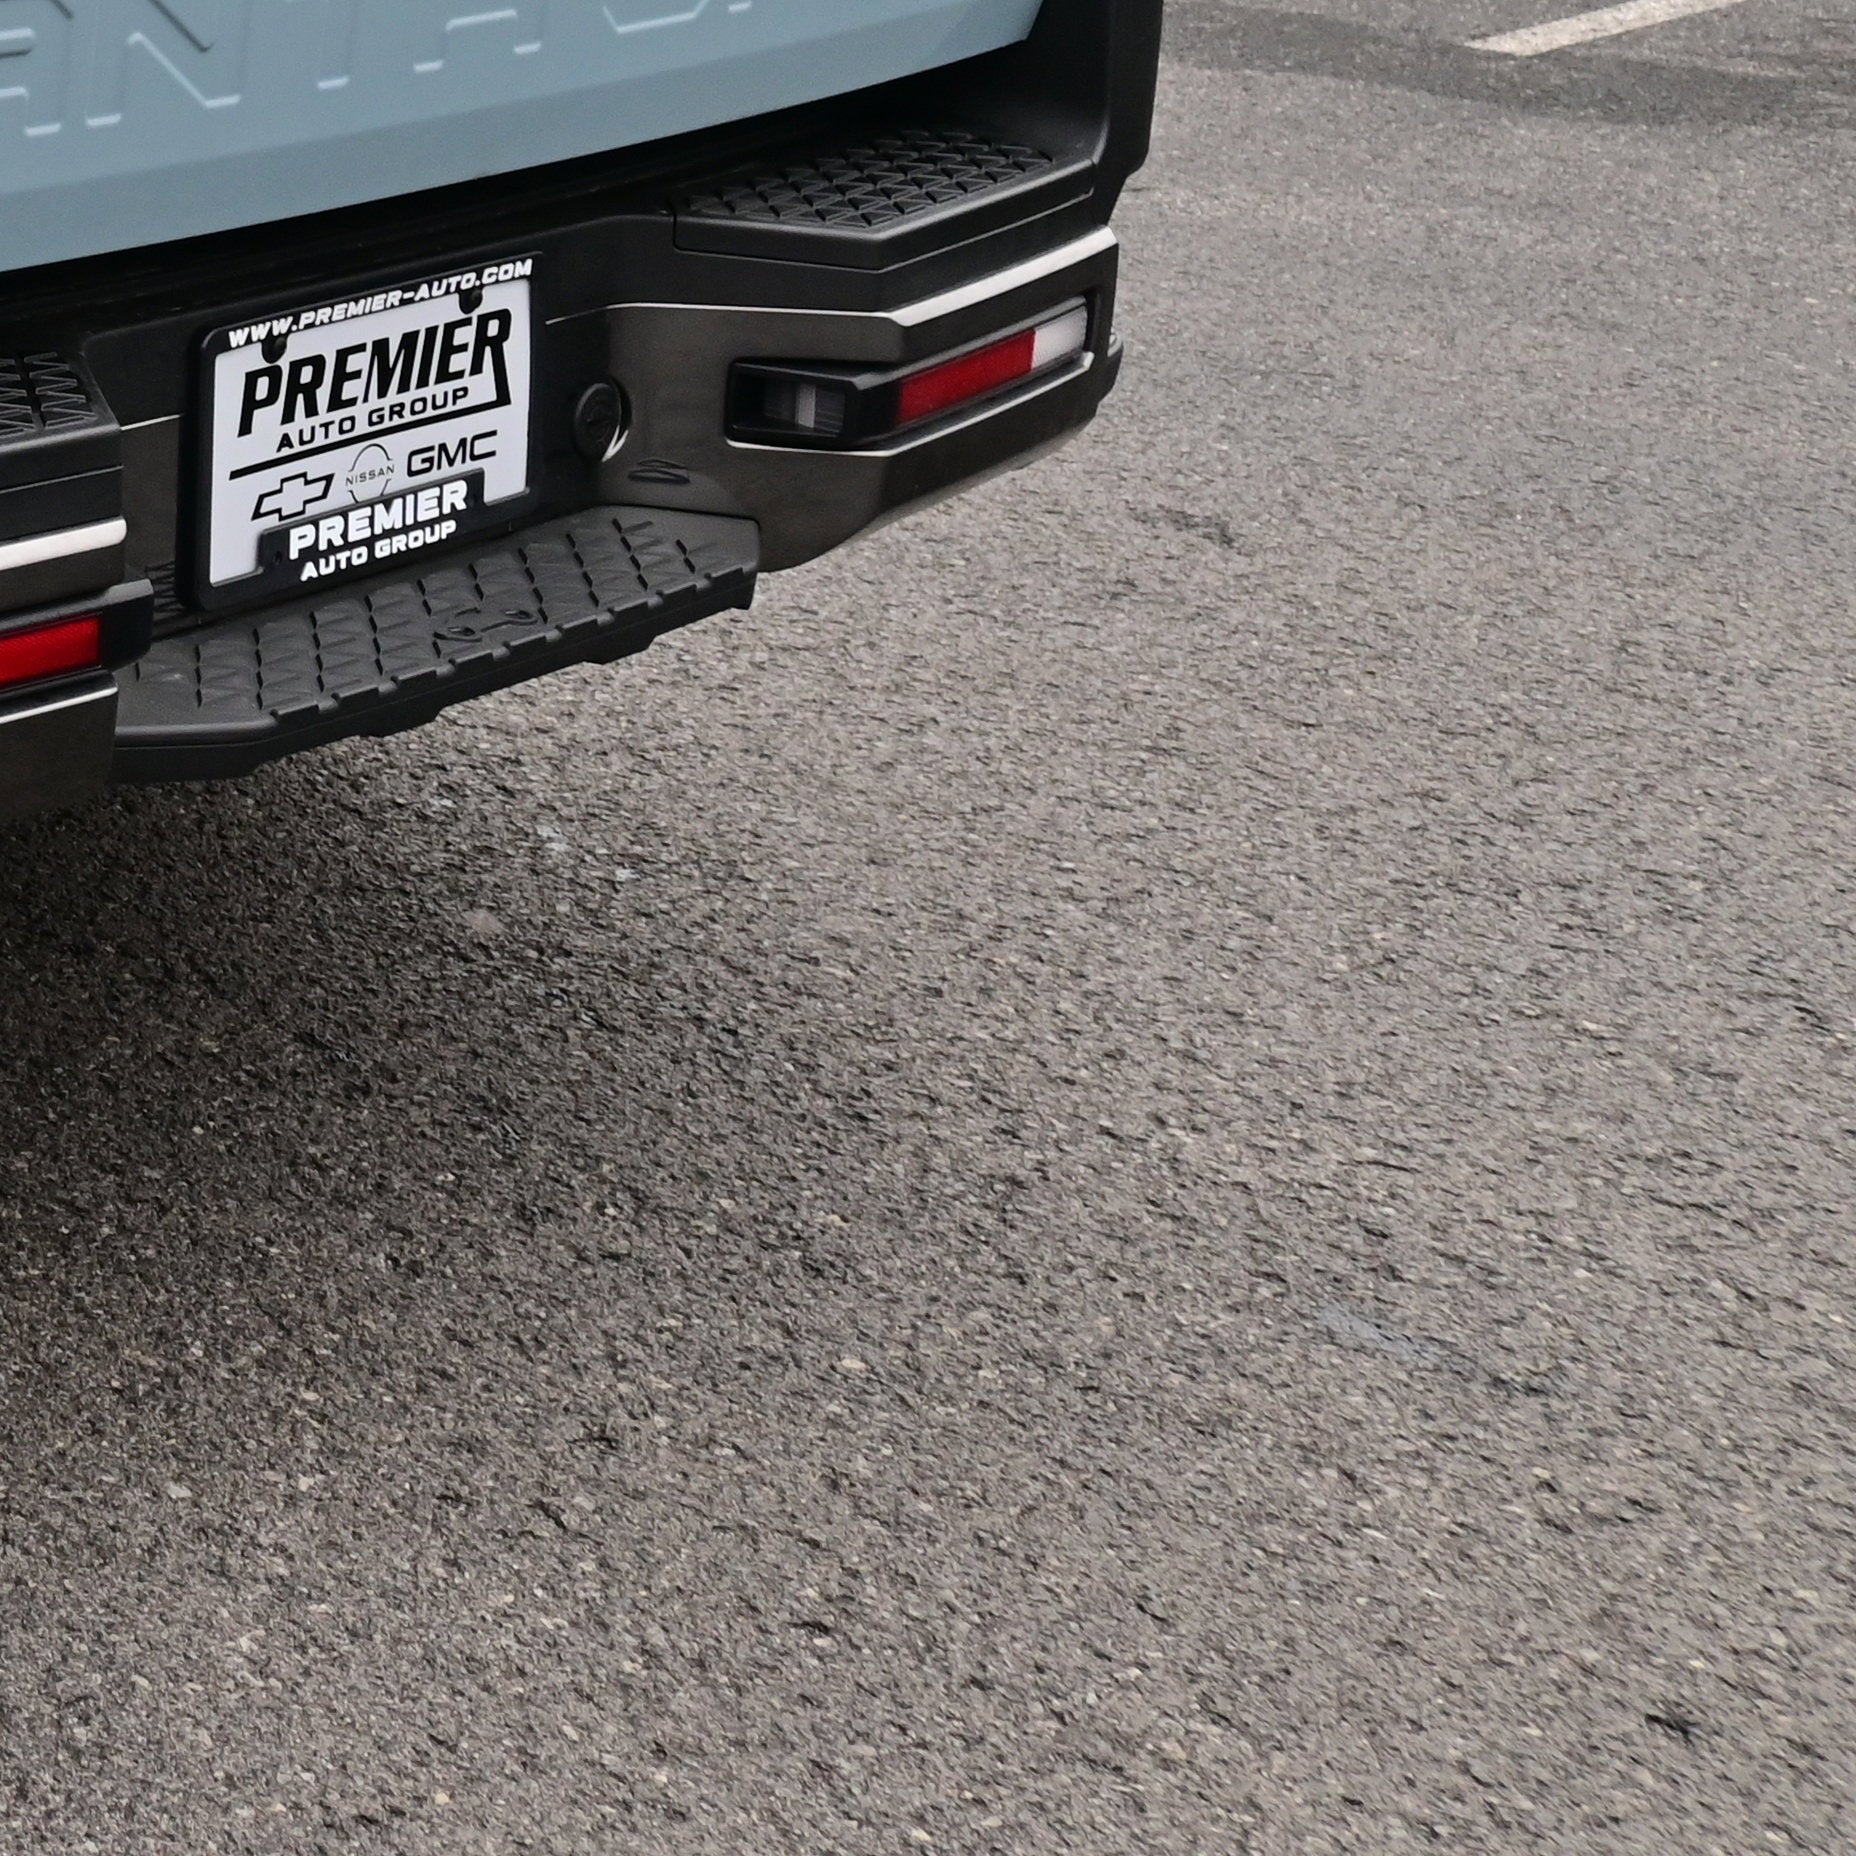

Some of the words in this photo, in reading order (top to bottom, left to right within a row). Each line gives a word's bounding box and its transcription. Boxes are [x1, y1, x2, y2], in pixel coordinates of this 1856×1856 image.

[228, 258, 533, 350] WWW.PREMIER-AUTO.COM
[237, 307, 513, 438] PREMIER
[275, 414, 357, 454] AUTO
[367, 386, 470, 428] GROUP
[406, 429, 498, 478] GMC
[345, 463, 396, 487] NISSAN
[288, 479, 469, 561] PREMIER
[299, 547, 368, 582] AUTO
[374, 519, 458, 559] GROUP
